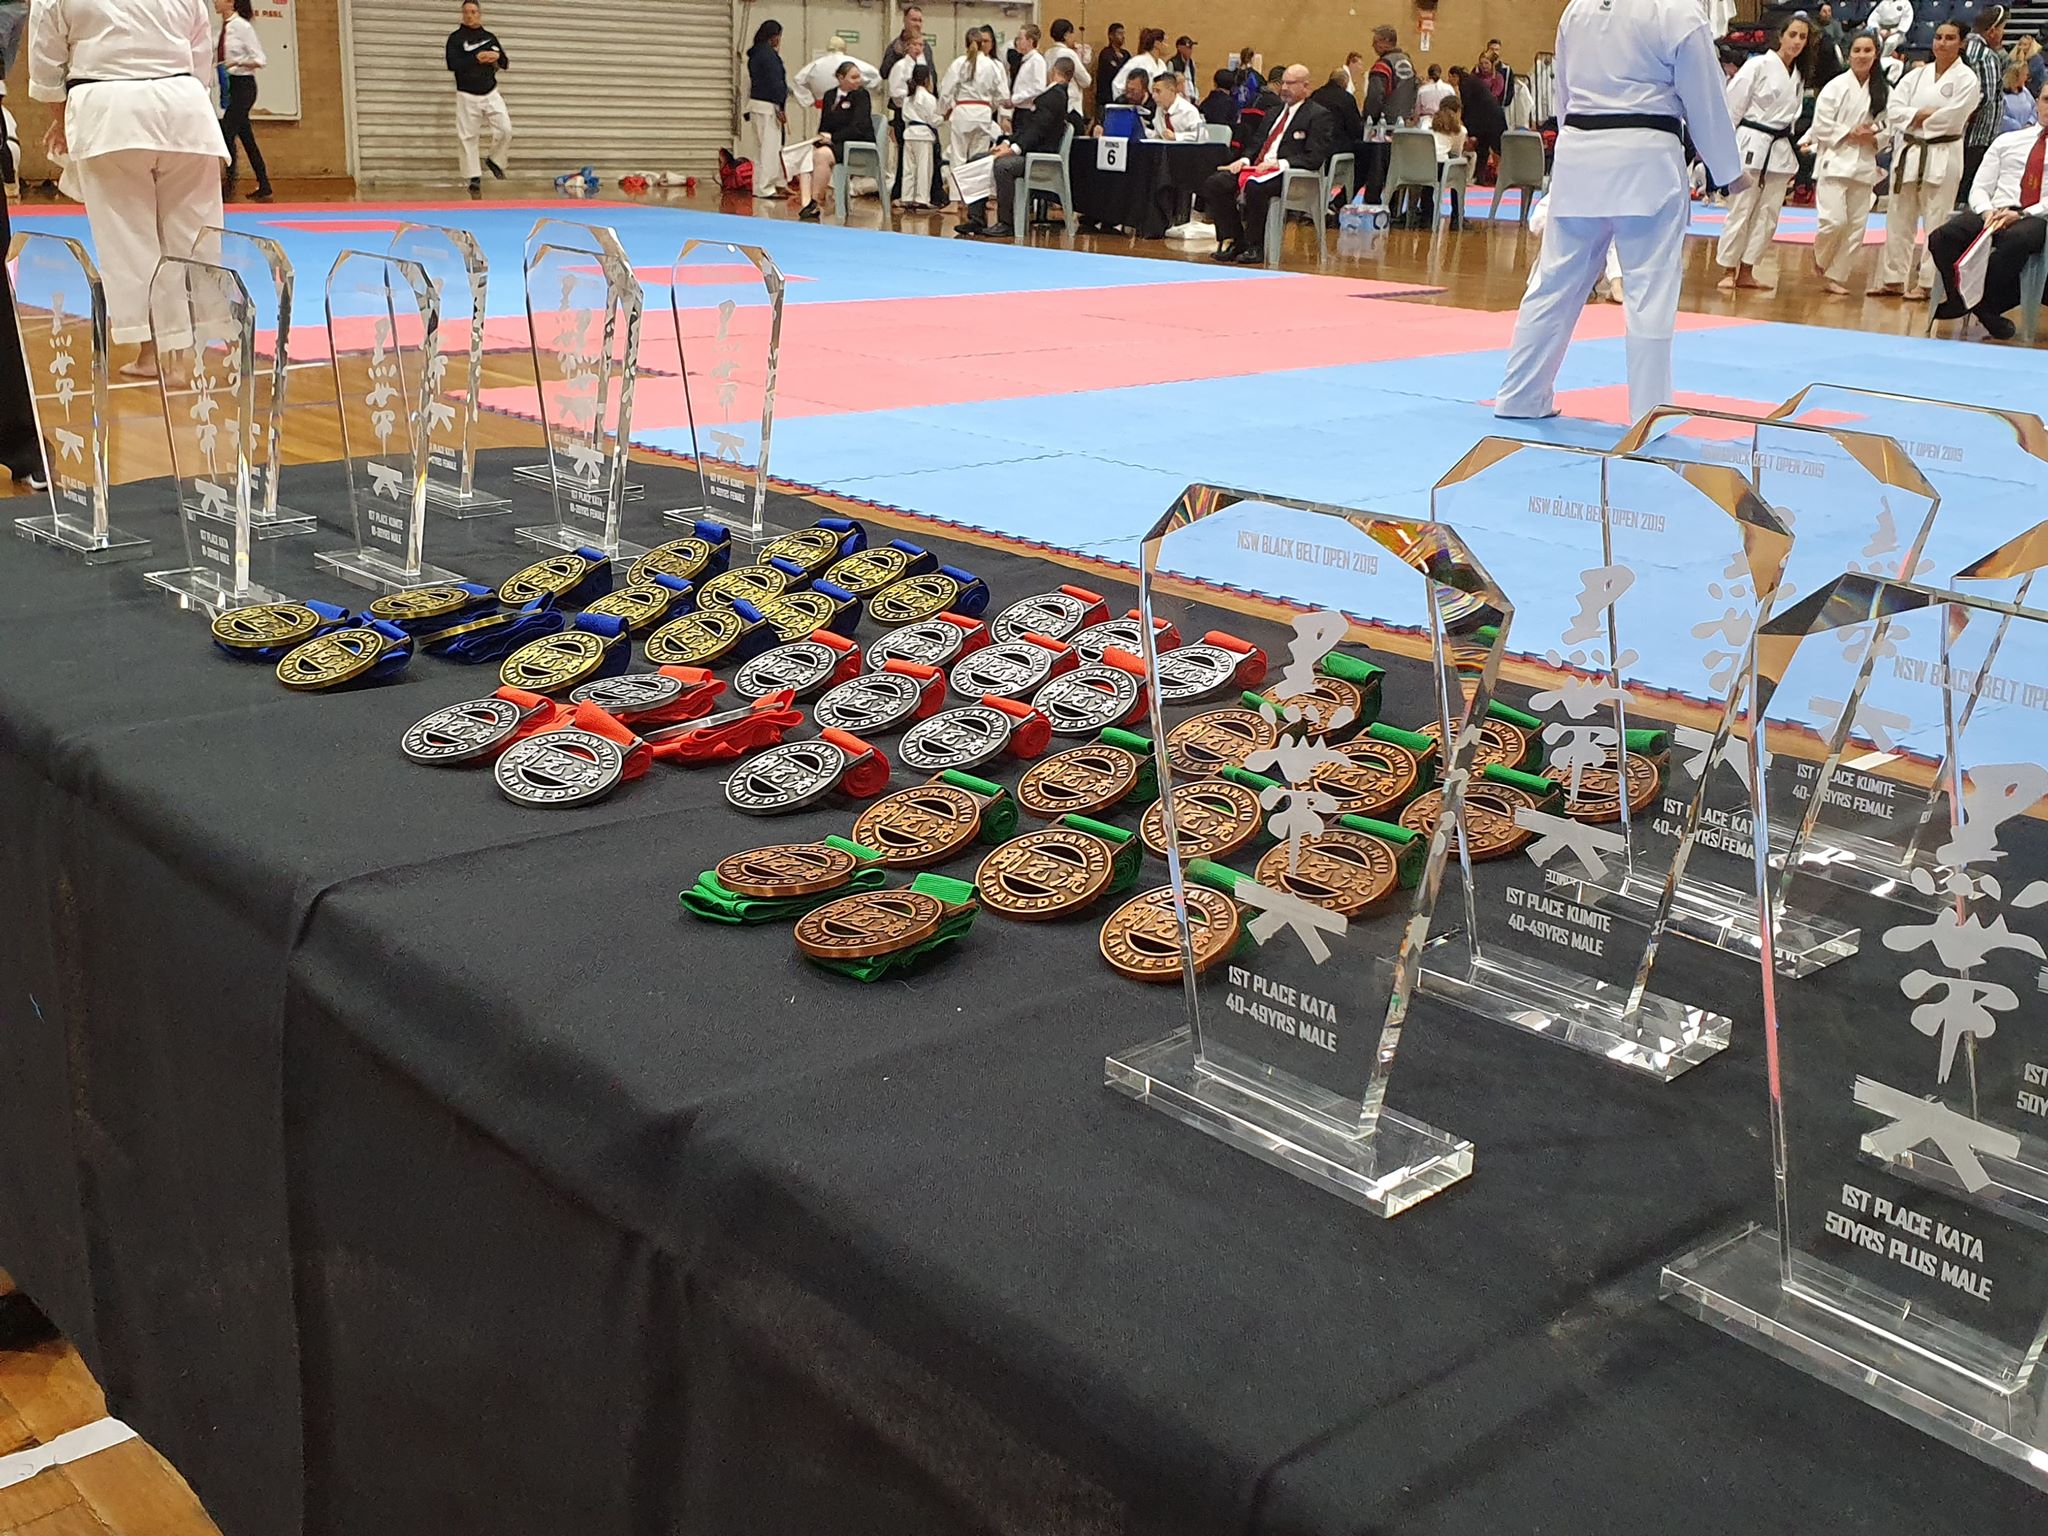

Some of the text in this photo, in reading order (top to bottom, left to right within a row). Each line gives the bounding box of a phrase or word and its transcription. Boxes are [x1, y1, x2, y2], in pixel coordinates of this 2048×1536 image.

[1107, 149, 1116, 165] 6
[1777, 456, 1800, 474] OPEN
[1528, 496, 1550, 515] NSW
[1552, 499, 1583, 520] BLACK
[1612, 508, 1639, 528] OPEN
[1641, 512, 1665, 532] 2019
[1238, 530, 1379, 576] NSW BLACK BELT OPEN 2019
[849, 675, 914, 700] GO-KAN-RYU
[1066, 670, 1131, 699] GO-KAN-RYU
[1893, 655, 1928, 683] NSW
[1930, 663, 1978, 694] BACK
[1981, 674, 2020, 704] BELT
[820, 704, 883, 727] KARATE-DO
[942, 709, 1002, 739] GO-KAN-RYU
[1202, 712, 1270, 744] GO-KAN-RYU
[535, 733, 615, 769] GO-KAN-RYU
[778, 744, 833, 777] GO-KAN-RYU
[903, 736, 964, 765] KARATE-DO
[1060, 748, 1129, 778] GO-KAN-RYU
[1342, 743, 1409, 776] O-KAN-RYU
[501, 763, 582, 799] KARATE-DO
[732, 771, 788, 804] KARATE-DO
[1023, 779, 1090, 809] KARATE-DO
[1797, 762, 1896, 798] 1ST ACE KUMITE
[896, 788, 973, 823] GO-KAN-RYU
[1175, 784, 1253, 821] GO-KAN-RYU
[1663, 797, 1753, 835] 1ST PACE KAT
[1793, 784, 1852, 808] 40-9YRS
[1853, 797, 1895, 820] FEMALE
[860, 822, 933, 857] KARATE-DO
[1018, 833, 1104, 871] GO-KAN-RYU
[1652, 818, 1756, 860] 40-4YRS FEMA
[982, 869, 1066, 908] KARATE-DO
[1506, 886, 1611, 933] 1ST PLACE KUMITE
[1107, 928, 1179, 967] KARATE-D
[1508, 913, 1604, 957] 40-49YRS MALE
[1228, 965, 1337, 1024] 1ST PLACE KATA
[1225, 992, 1337, 1053] 40-49YRS MALE
[2017, 1090, 2048, 1117] 50Y
[1841, 1184, 1984, 1263] 1ST PLACE KATA
[1825, 1210, 1993, 1301] 50YRS PLUS MALE
